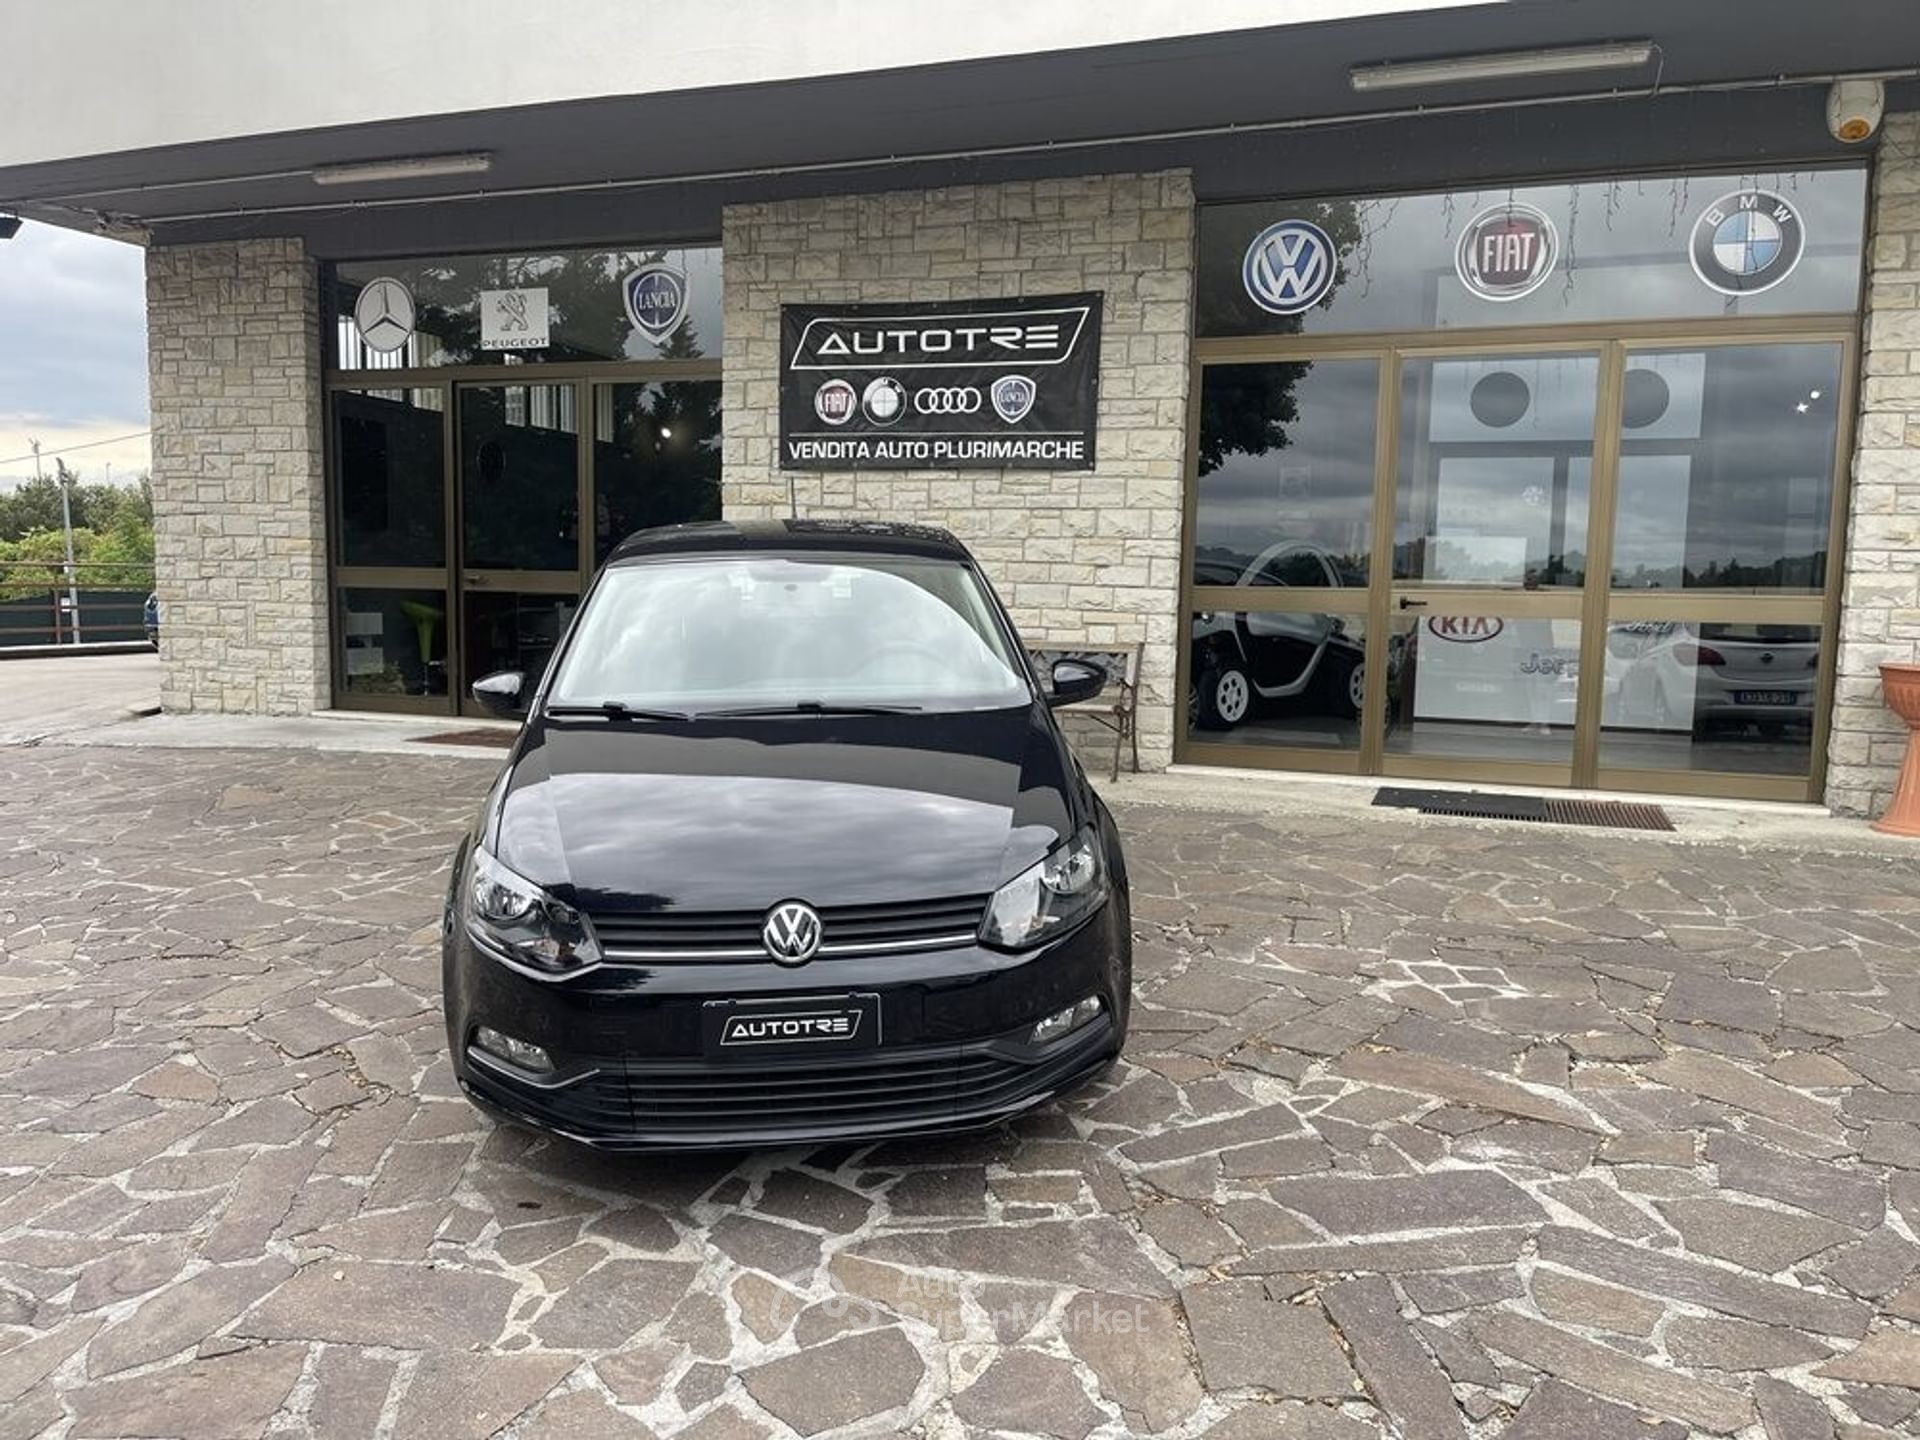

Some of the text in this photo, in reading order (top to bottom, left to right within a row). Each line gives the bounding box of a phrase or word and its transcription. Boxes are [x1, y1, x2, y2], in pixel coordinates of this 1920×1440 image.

[1705, 196, 1792, 226] BMW
[1483, 233, 1535, 272] FIAT
[639, 291, 676, 309] LANCIA
[482, 338, 547, 347] PEUGEOT
[816, 325, 1059, 355] AUTOTRE
[825, 393, 848, 412] FIAT
[789, 441, 1084, 459] VENDITA AUTO PLURIMARCHE
[1441, 616, 1490, 634] KIA
[731, 1018, 849, 1037] AUTOTRE
